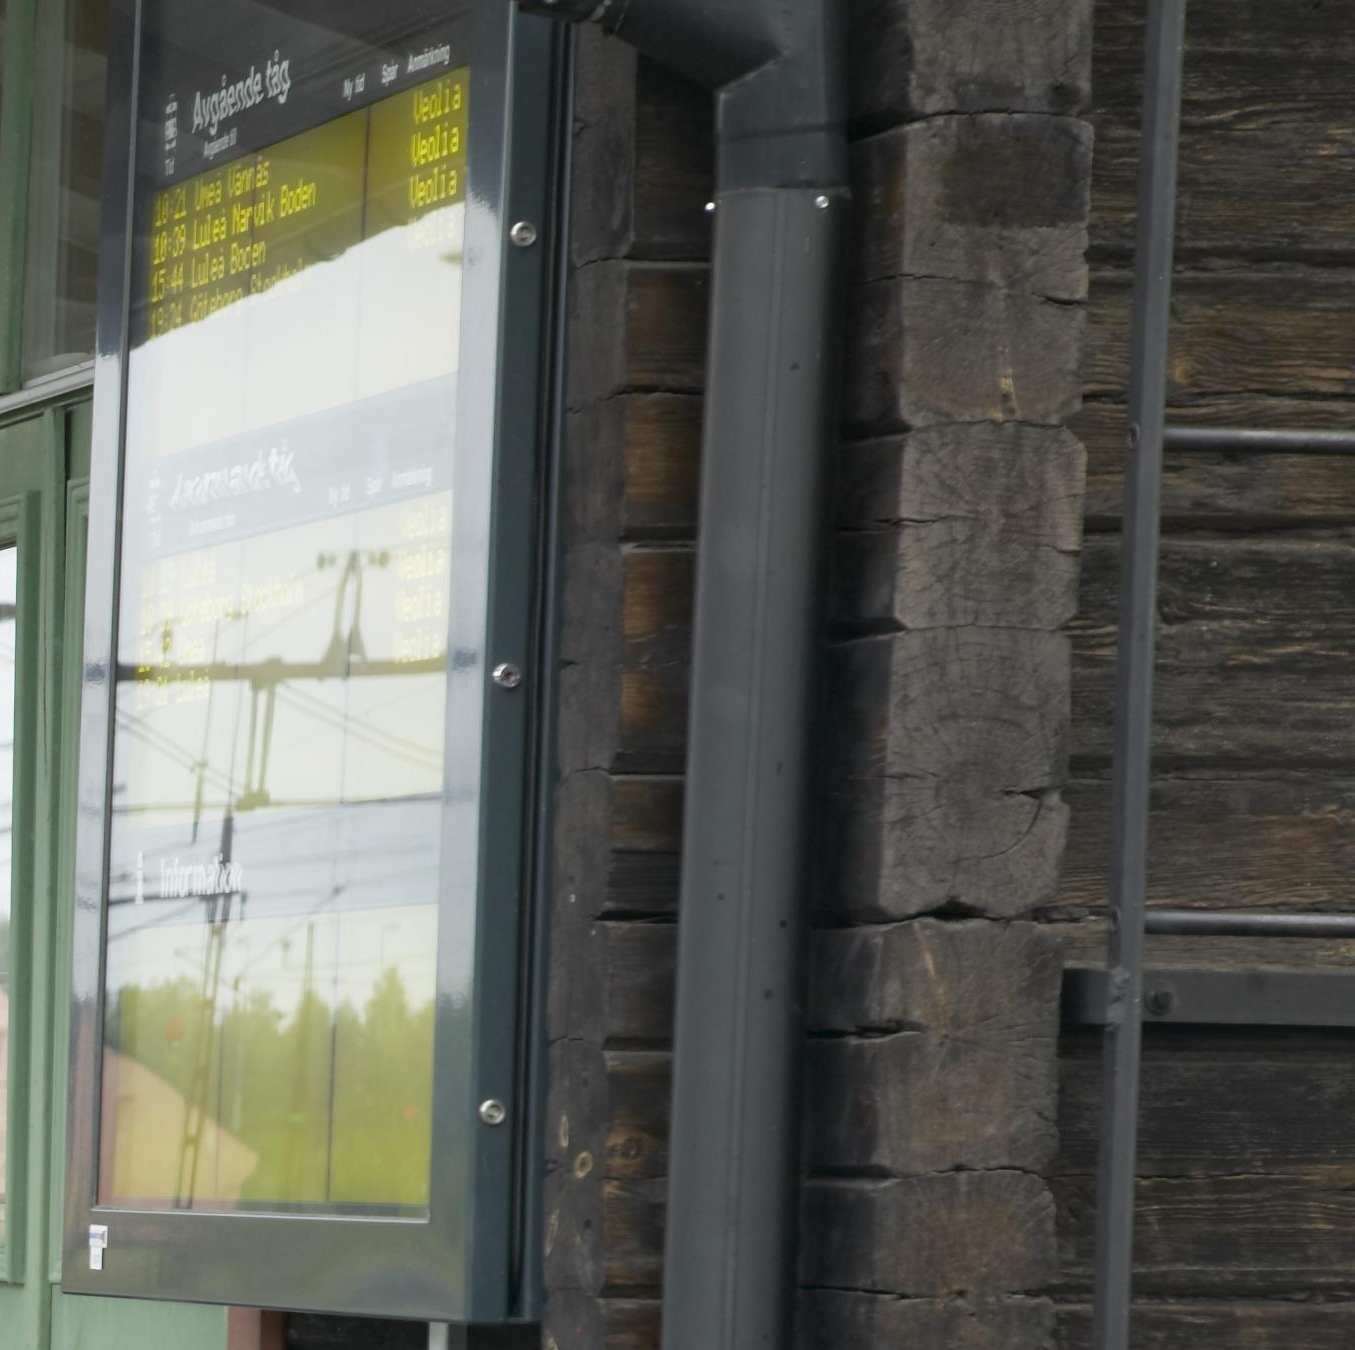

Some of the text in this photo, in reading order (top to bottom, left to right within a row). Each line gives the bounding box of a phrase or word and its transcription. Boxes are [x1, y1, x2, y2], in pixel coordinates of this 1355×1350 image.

[192, 48, 291, 136] Avgående tåg
[413, 79, 461, 124] Veolia
[411, 122, 459, 167] Veolia
[409, 164, 457, 209] Veolia
[153, 178, 316, 265] 10:39 Luleå Narvik Boden
[152, 240, 266, 303] 15:44 Luleå Boden
[159, 852, 243, 898] Information
